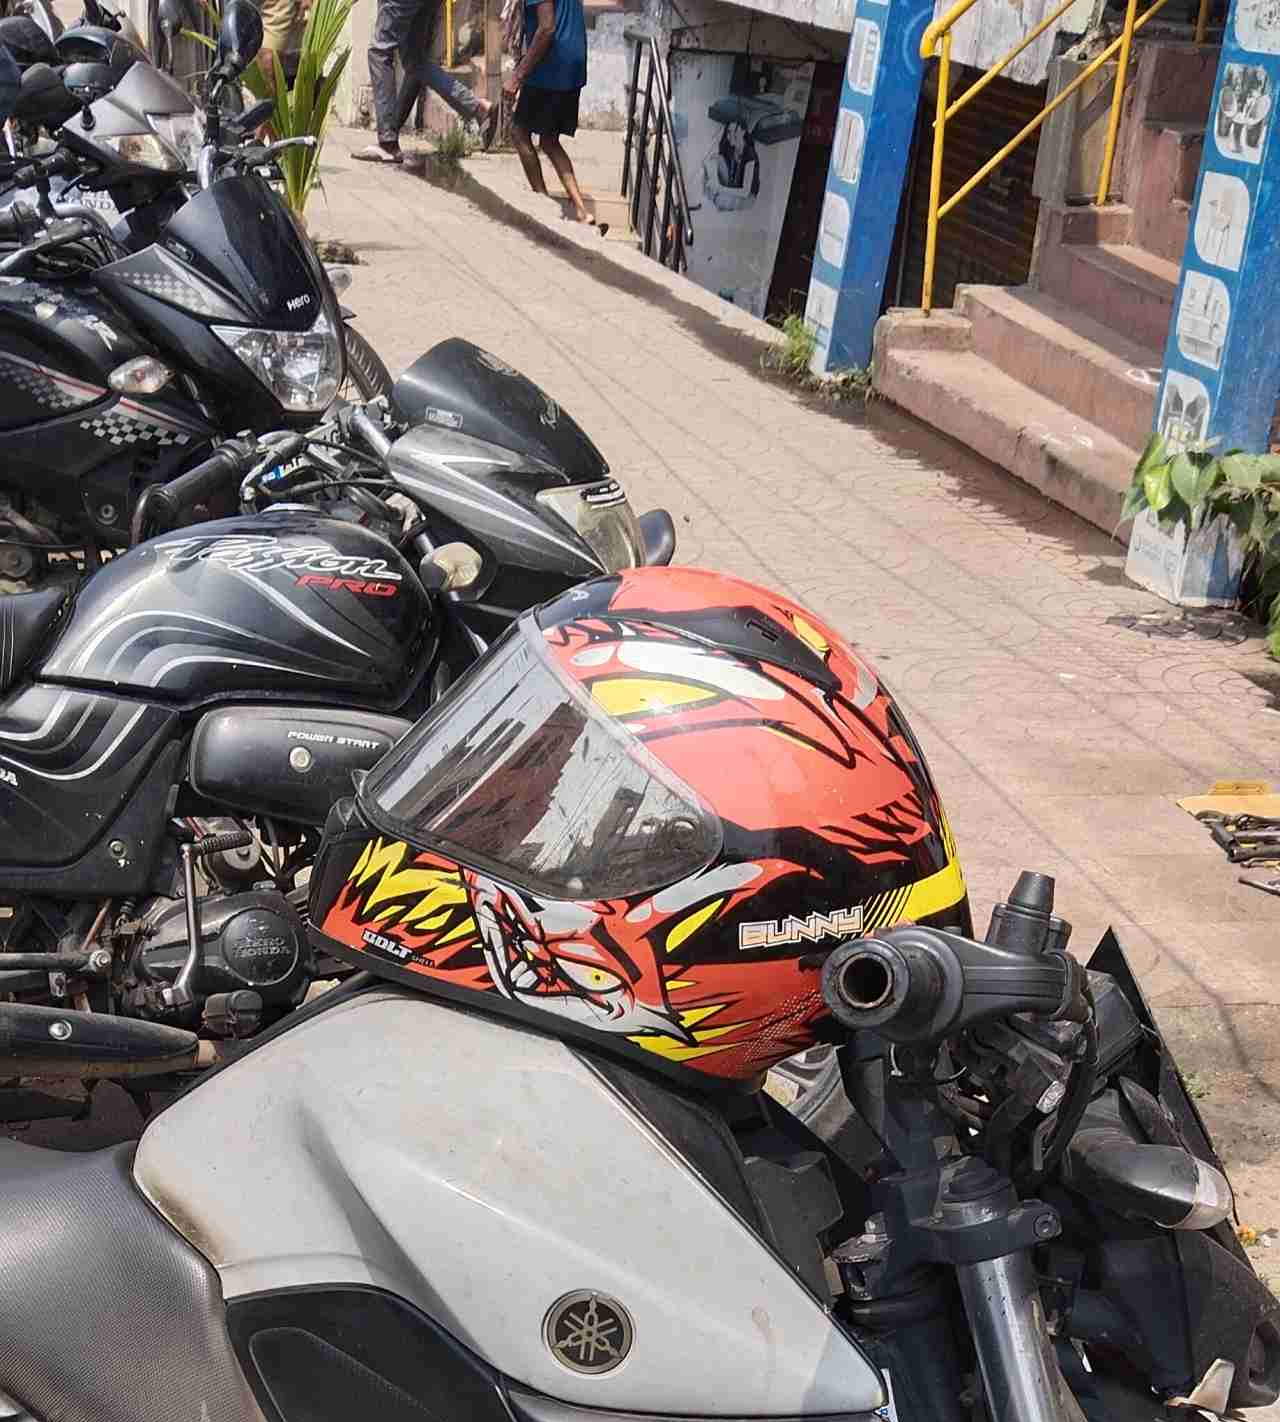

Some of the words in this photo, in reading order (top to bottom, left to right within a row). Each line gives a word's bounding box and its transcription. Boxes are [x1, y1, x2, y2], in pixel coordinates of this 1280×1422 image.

[286, 294, 311, 311] Hero
[294, 574, 398, 597] PRO
[287, 730, 334, 743] POWER
[336, 737, 380, 750] START
[739, 905, 864, 950] BUNNY
[362, 929, 413, 959] BOLT
